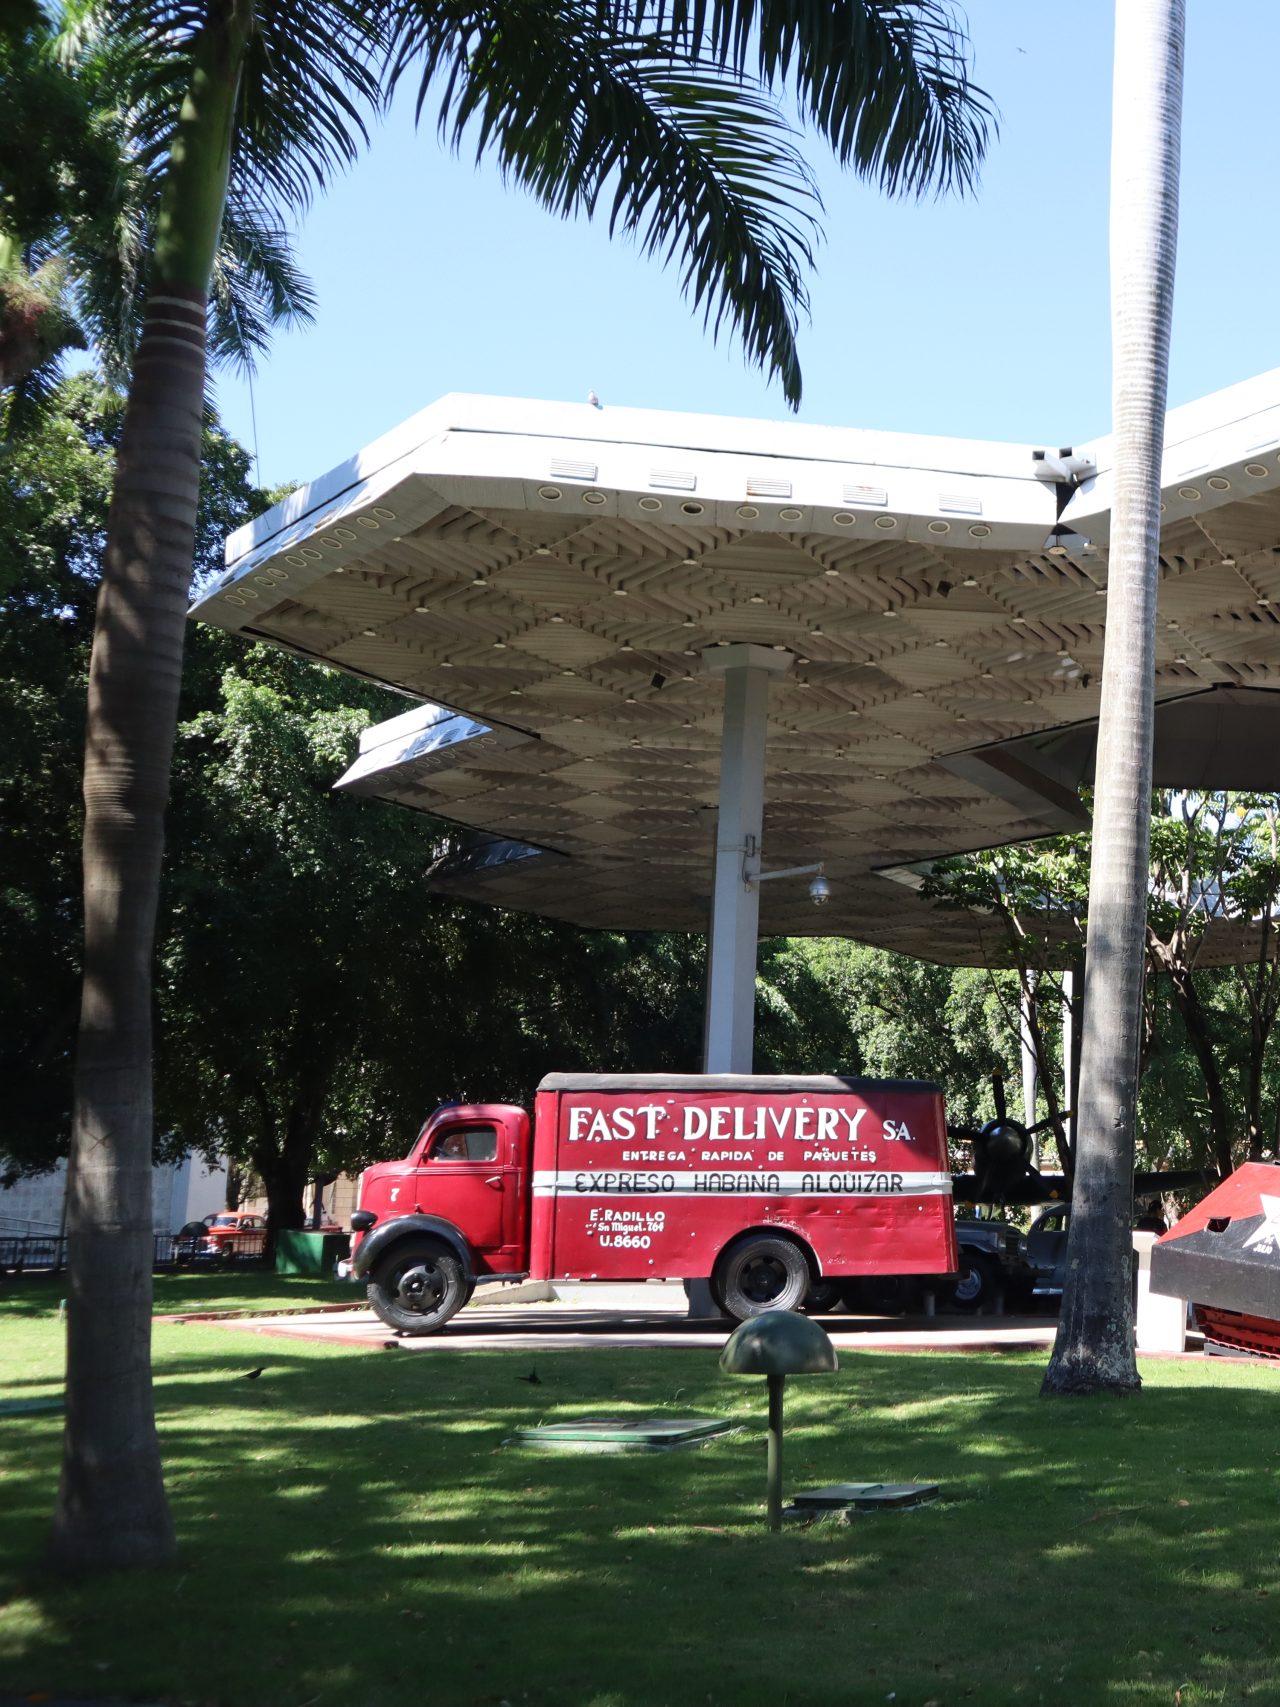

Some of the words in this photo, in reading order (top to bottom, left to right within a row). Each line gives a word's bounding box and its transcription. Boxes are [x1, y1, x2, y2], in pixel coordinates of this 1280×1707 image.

[568, 1105, 668, 1141] FAST
[683, 1106, 868, 1141] DELIVERY
[622, 1151, 686, 1161] ENTREGA
[701, 1151, 752, 1161] RAPIDA
[768, 1151, 785, 1161] DE
[803, 1150, 877, 1163] PAQUETES
[574, 1172, 676, 1193] EXPRESO
[694, 1173, 781, 1193] HABANA
[801, 1173, 904, 1193] ALQUIZAR
[390, 1187, 400, 1202] 7
[599, 1234, 651, 1249] U.8660
[1252, 1243, 1274, 1255] JULIO
